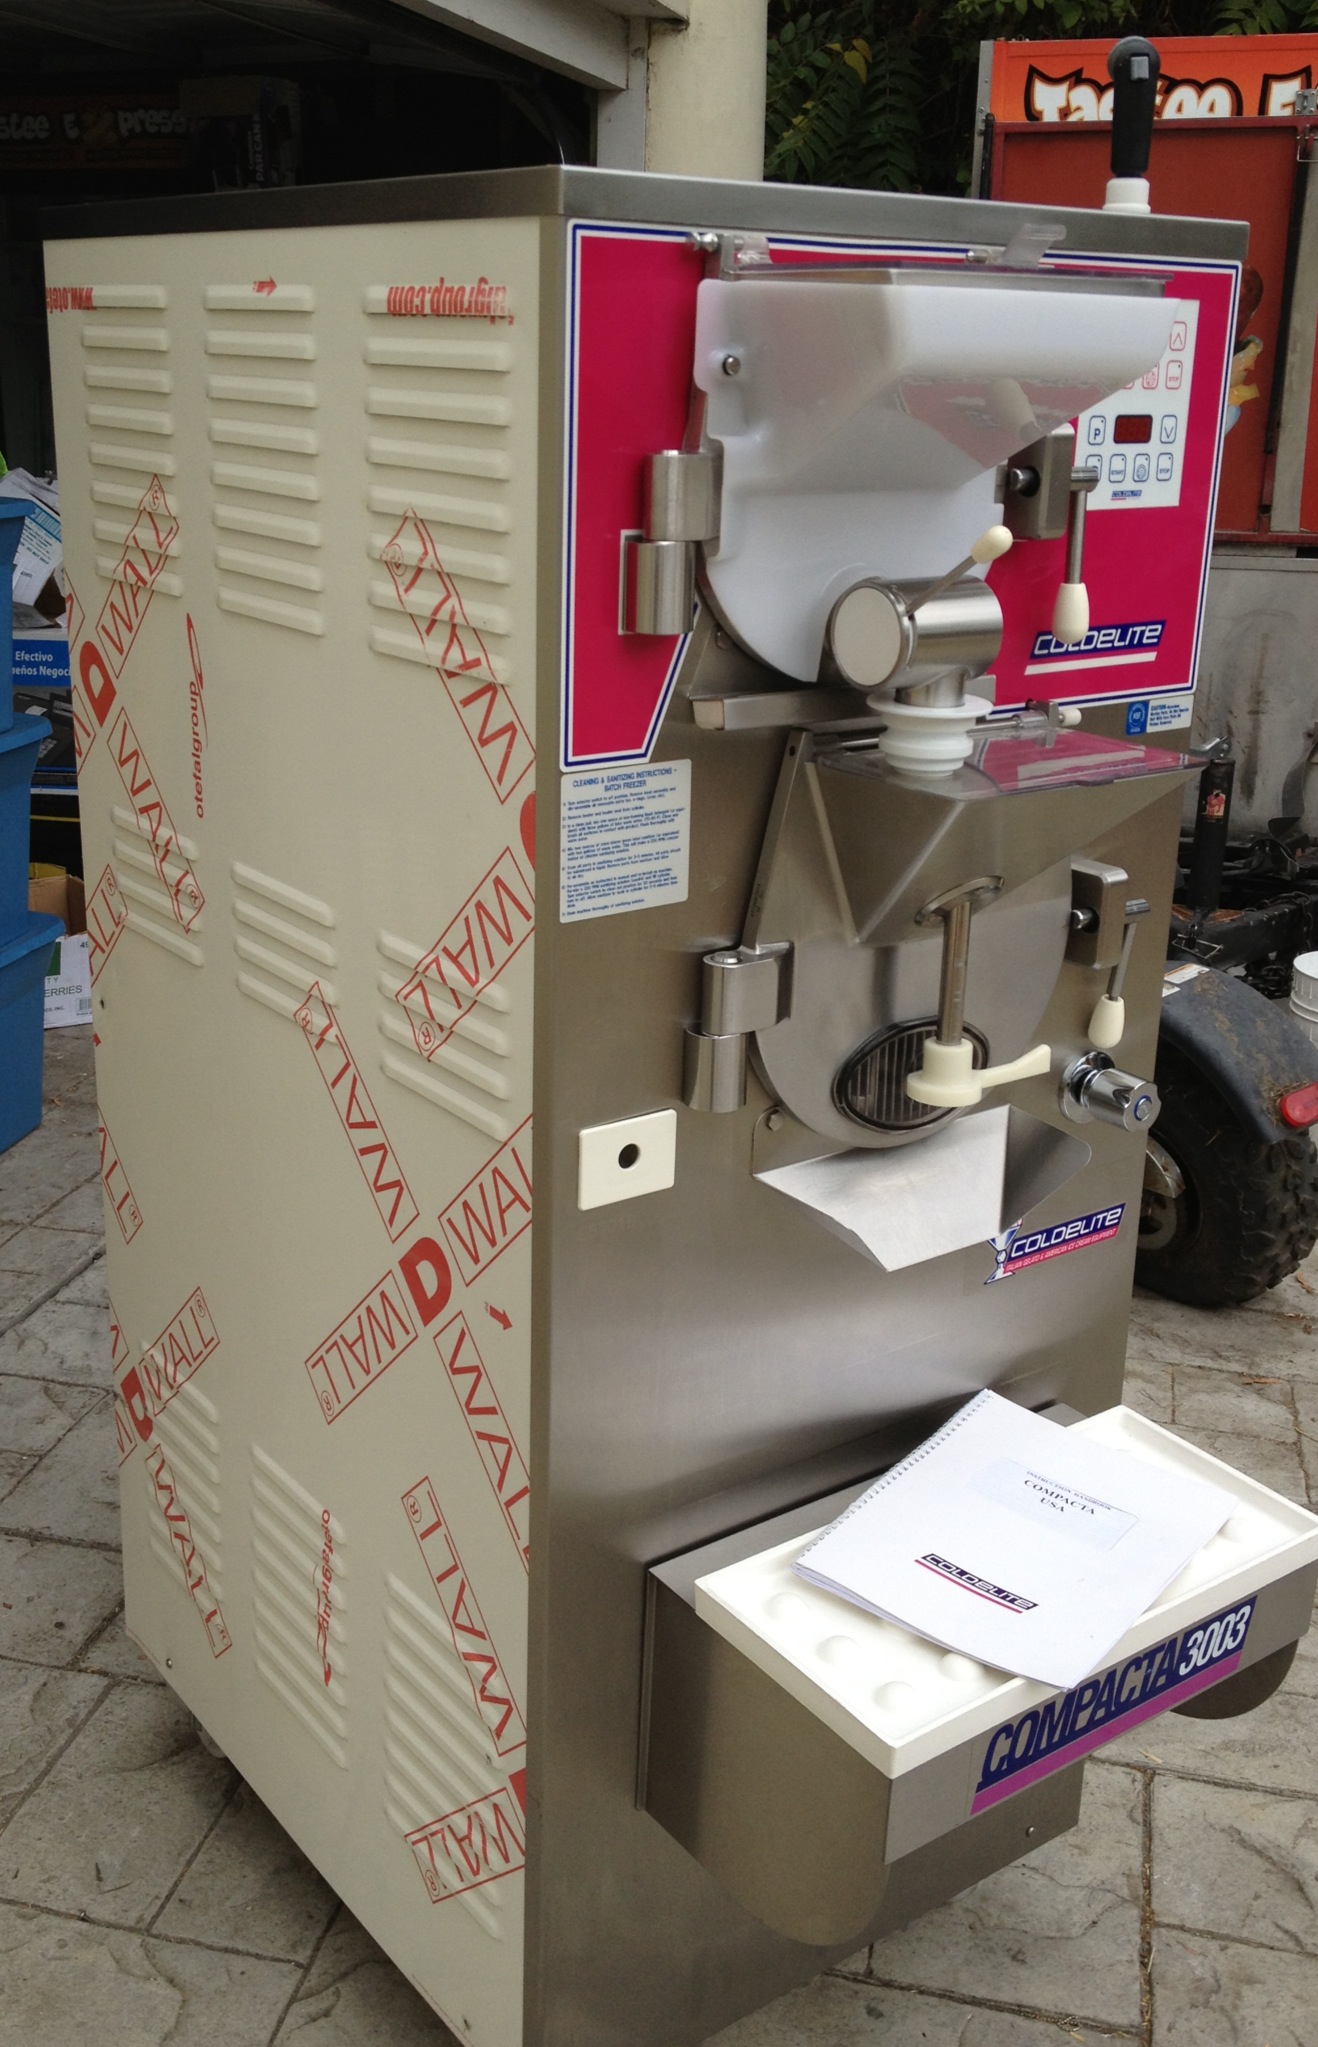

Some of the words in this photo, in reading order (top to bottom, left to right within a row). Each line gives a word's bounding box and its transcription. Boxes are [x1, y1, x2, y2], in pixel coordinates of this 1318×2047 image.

[1094, 428, 1101, 440] P
[15, 651, 53, 662] Efectivo
[189, 681, 204, 819] otefalgroup
[573, 777, 599, 788] CLEANING
[607, 773, 634, 783] SANITIZING
[636, 767, 672, 779] INSTRUCTIONS
[604, 784, 622, 792] BATCH
[623, 780, 647, 790] FREEZER
[398, 1237, 452, 1327] D
[1024, 1479, 1095, 1515] COMPACTA
[1040, 1497, 1065, 1512] USA
[981, 1637, 1180, 1782] COMPACTA
[1179, 1604, 1251, 1676] 3003
